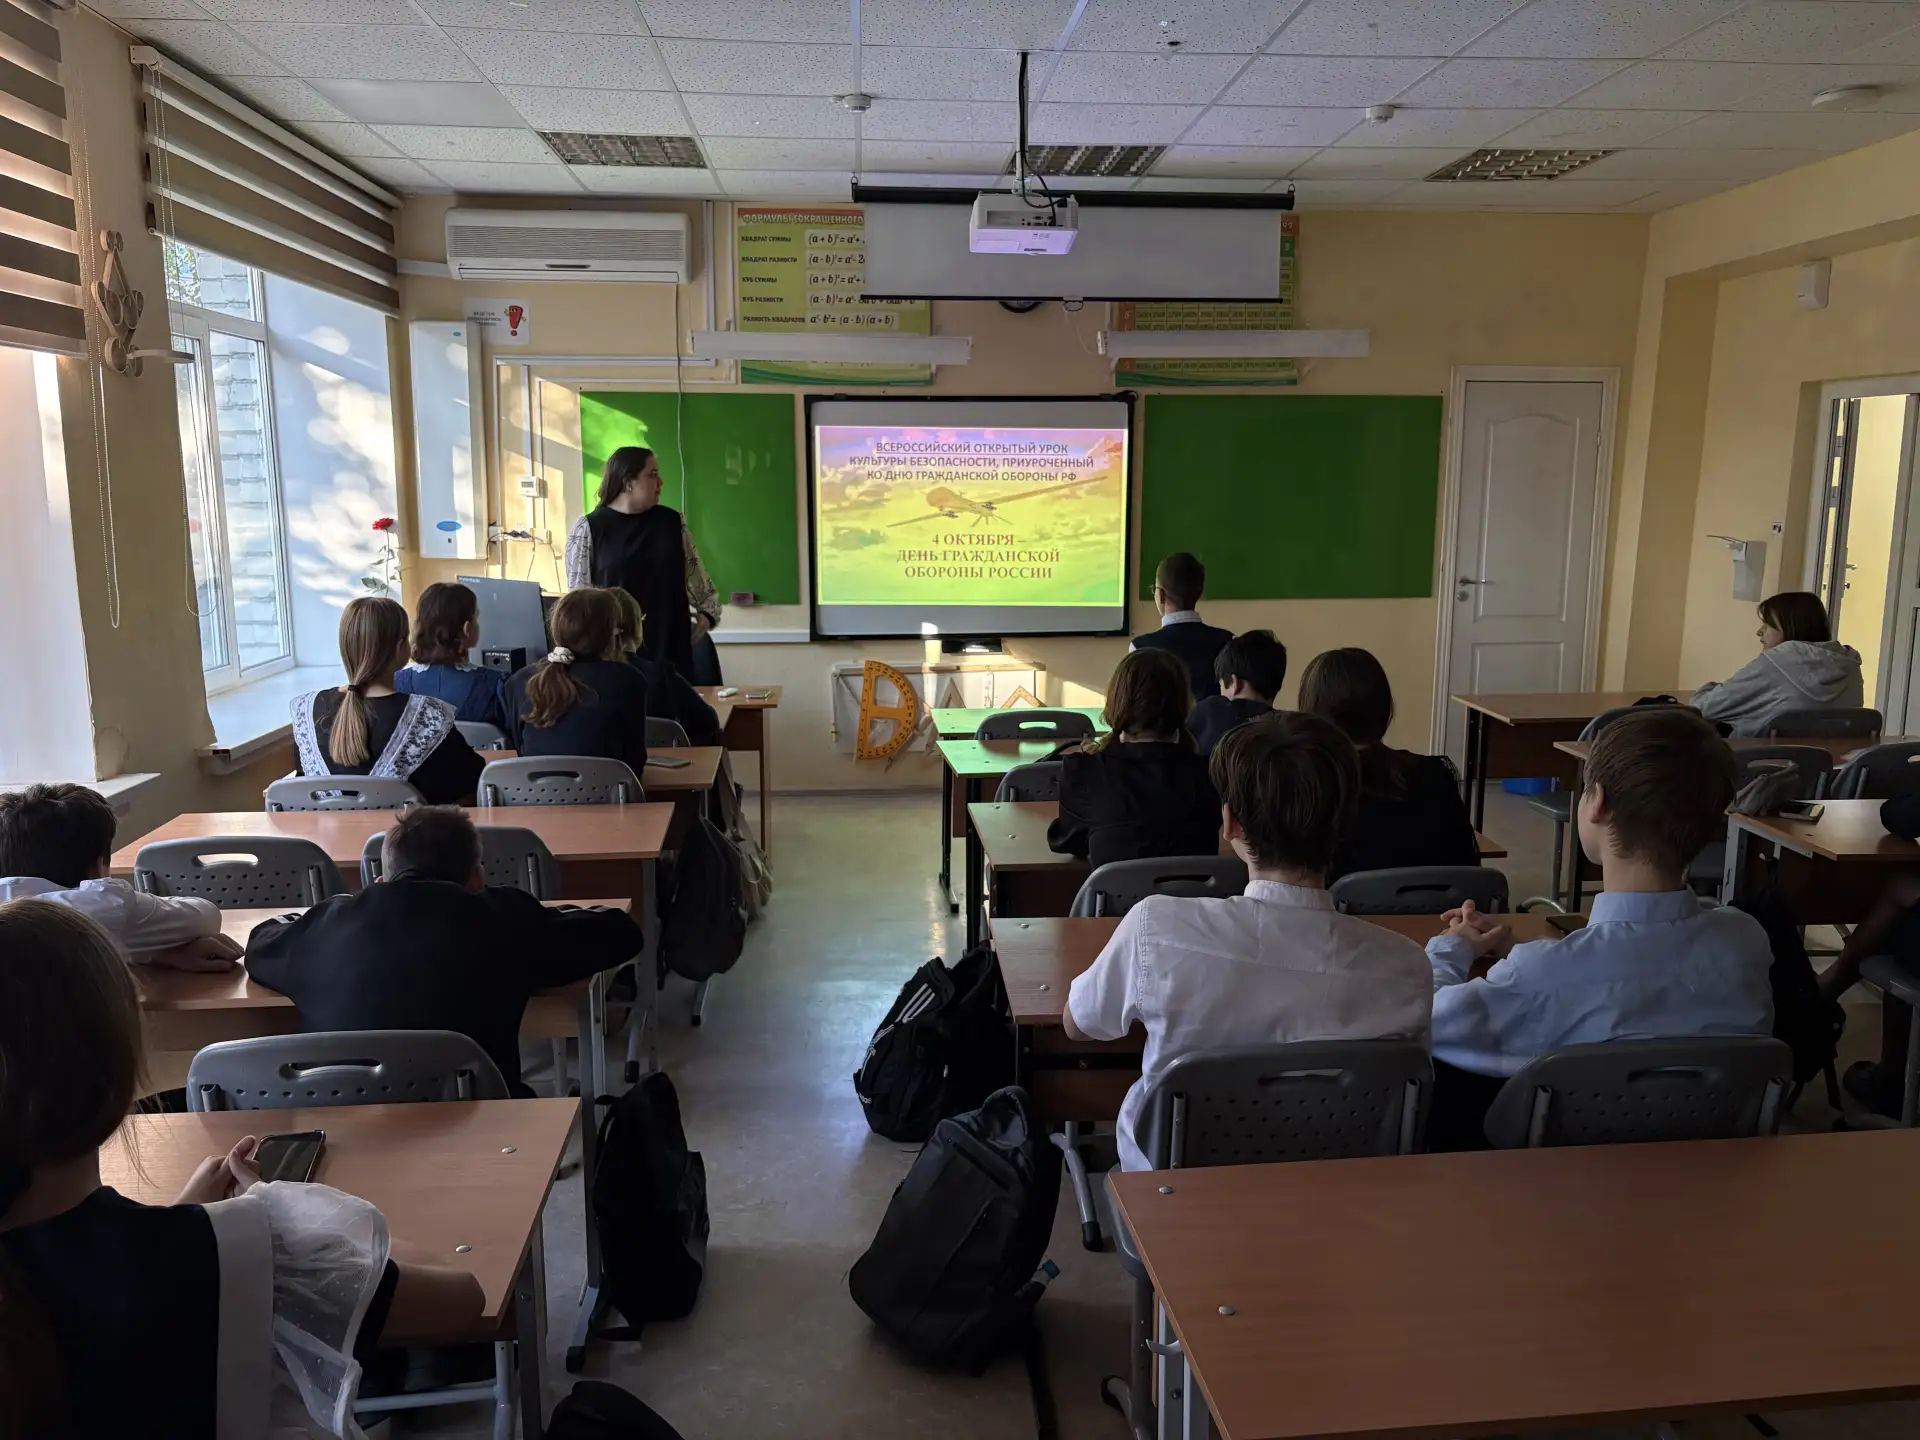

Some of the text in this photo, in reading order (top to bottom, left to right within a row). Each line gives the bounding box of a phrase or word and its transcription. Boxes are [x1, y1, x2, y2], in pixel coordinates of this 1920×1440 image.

[742, 213, 792, 223] ФОРМУЛЫ
[741, 235, 768, 243] КВАДРАТ
[876, 441, 1068, 454] ВСЕРОССИЙСКИЙ ОТКРЫТЫЙ УРОК
[849, 456, 1094, 468] КУЛЬТУРЫ БЕЗОПАСНОСТИ, ПРИУРОЧЕННЫЙ
[867, 469, 1077, 482] КО ДНЮ ГРАЖДАНСКОЙ ОБОРОНЫ РФ
[932, 533, 939, 545] 4
[943, 533, 1015, 545] ОКТЯБРЯ
[896, 547, 1060, 563] ДЕНЬ ГРАЖДАНСКОЙ
[904, 566, 1052, 579] ОБОРОНЫ РОССИИ
